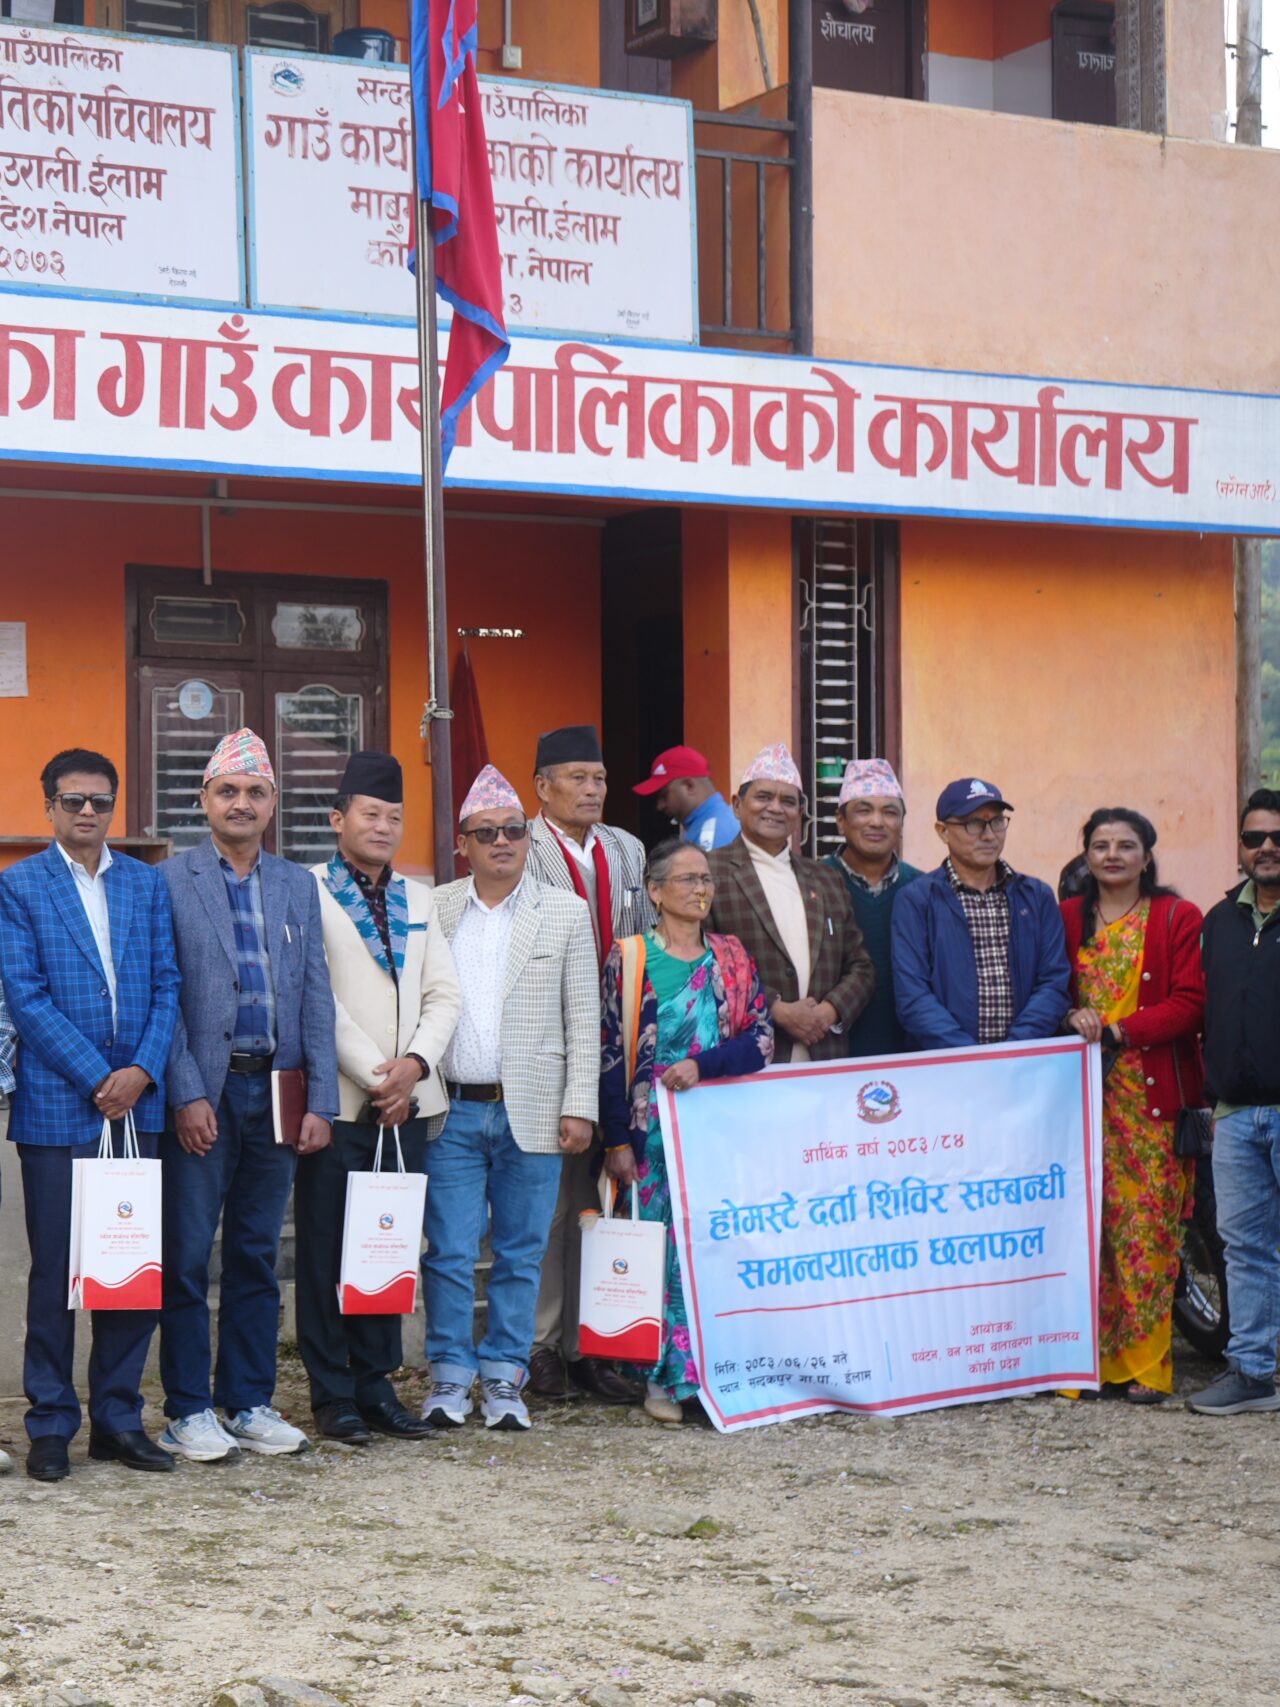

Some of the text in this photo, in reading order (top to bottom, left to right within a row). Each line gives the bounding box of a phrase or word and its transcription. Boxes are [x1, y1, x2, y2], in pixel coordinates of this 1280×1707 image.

[820, 12, 876, 46] शौचालय
[78, 84, 217, 150] सचिवालय
[264, 107, 331, 162] गाउँ
[565, 143, 684, 200] कार्यालय
[97, 314, 260, 433] गाउँ
[868, 386, 1200, 495] कार्यालय
[803, 1141, 848, 1164] आर्थिक
[856, 1137, 880, 1157] वर्ष
[709, 1162, 1066, 1242] होमस्टे दर्ता शिविर सम्बन्धी
[736, 1226, 1046, 1290] समन्वयात्मक छलफल
[969, 1356, 1022, 1374] कोशी प्रदेश
